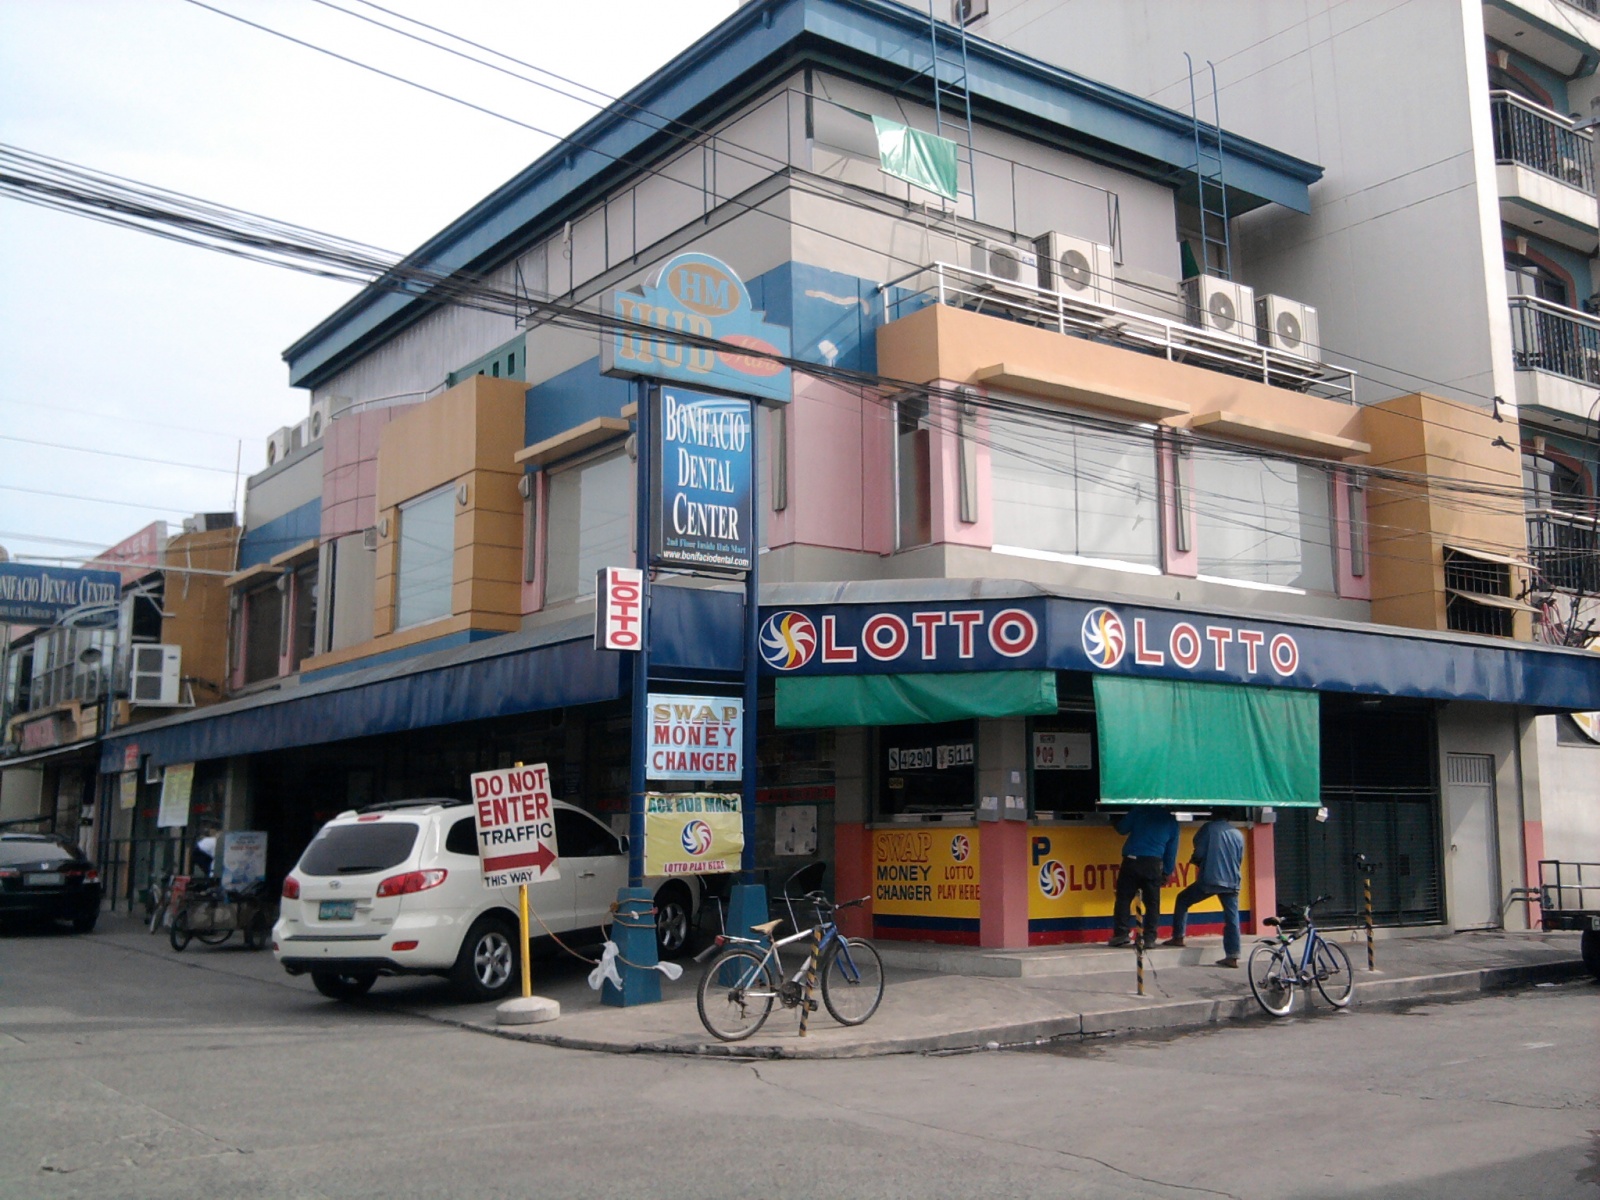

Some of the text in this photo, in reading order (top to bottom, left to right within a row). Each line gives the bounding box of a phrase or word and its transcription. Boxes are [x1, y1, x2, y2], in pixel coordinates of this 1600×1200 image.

[678, 268, 731, 311] HM
[618, 298, 716, 375] HUB
[665, 394, 746, 453] BONIFACIO
[677, 447, 735, 493] DENTAL
[672, 492, 740, 541] CENTER
[663, 549, 750, 567] www.bonifaciodental.com
[0, 573, 116, 605] NIFACIO DENTAL CENTER
[610, 571, 640, 647] LOTTO
[821, 607, 1039, 664] LOTTO
[1134, 617, 1300, 677] LOTTO
[653, 702, 738, 725] SWAP
[653, 724, 737, 748] MONEY
[652, 750, 738, 773] CHANGER
[474, 768, 546, 799] DO NOT
[477, 792, 550, 828] ENTER
[675, 797, 702, 813] HUB
[479, 822, 553, 847] TRAFFIC
[876, 831, 933, 863] SWAP
[484, 871, 534, 888] THIS WAY
[664, 860, 725, 873] LOTTO PLAY HERE
[876, 865, 932, 882] MONEY
[944, 866, 975, 880] LOTTO
[1069, 863, 1119, 891] LOTT
[876, 884, 932, 901] CHANGER
[937, 884, 981, 901] PLAY HERE
